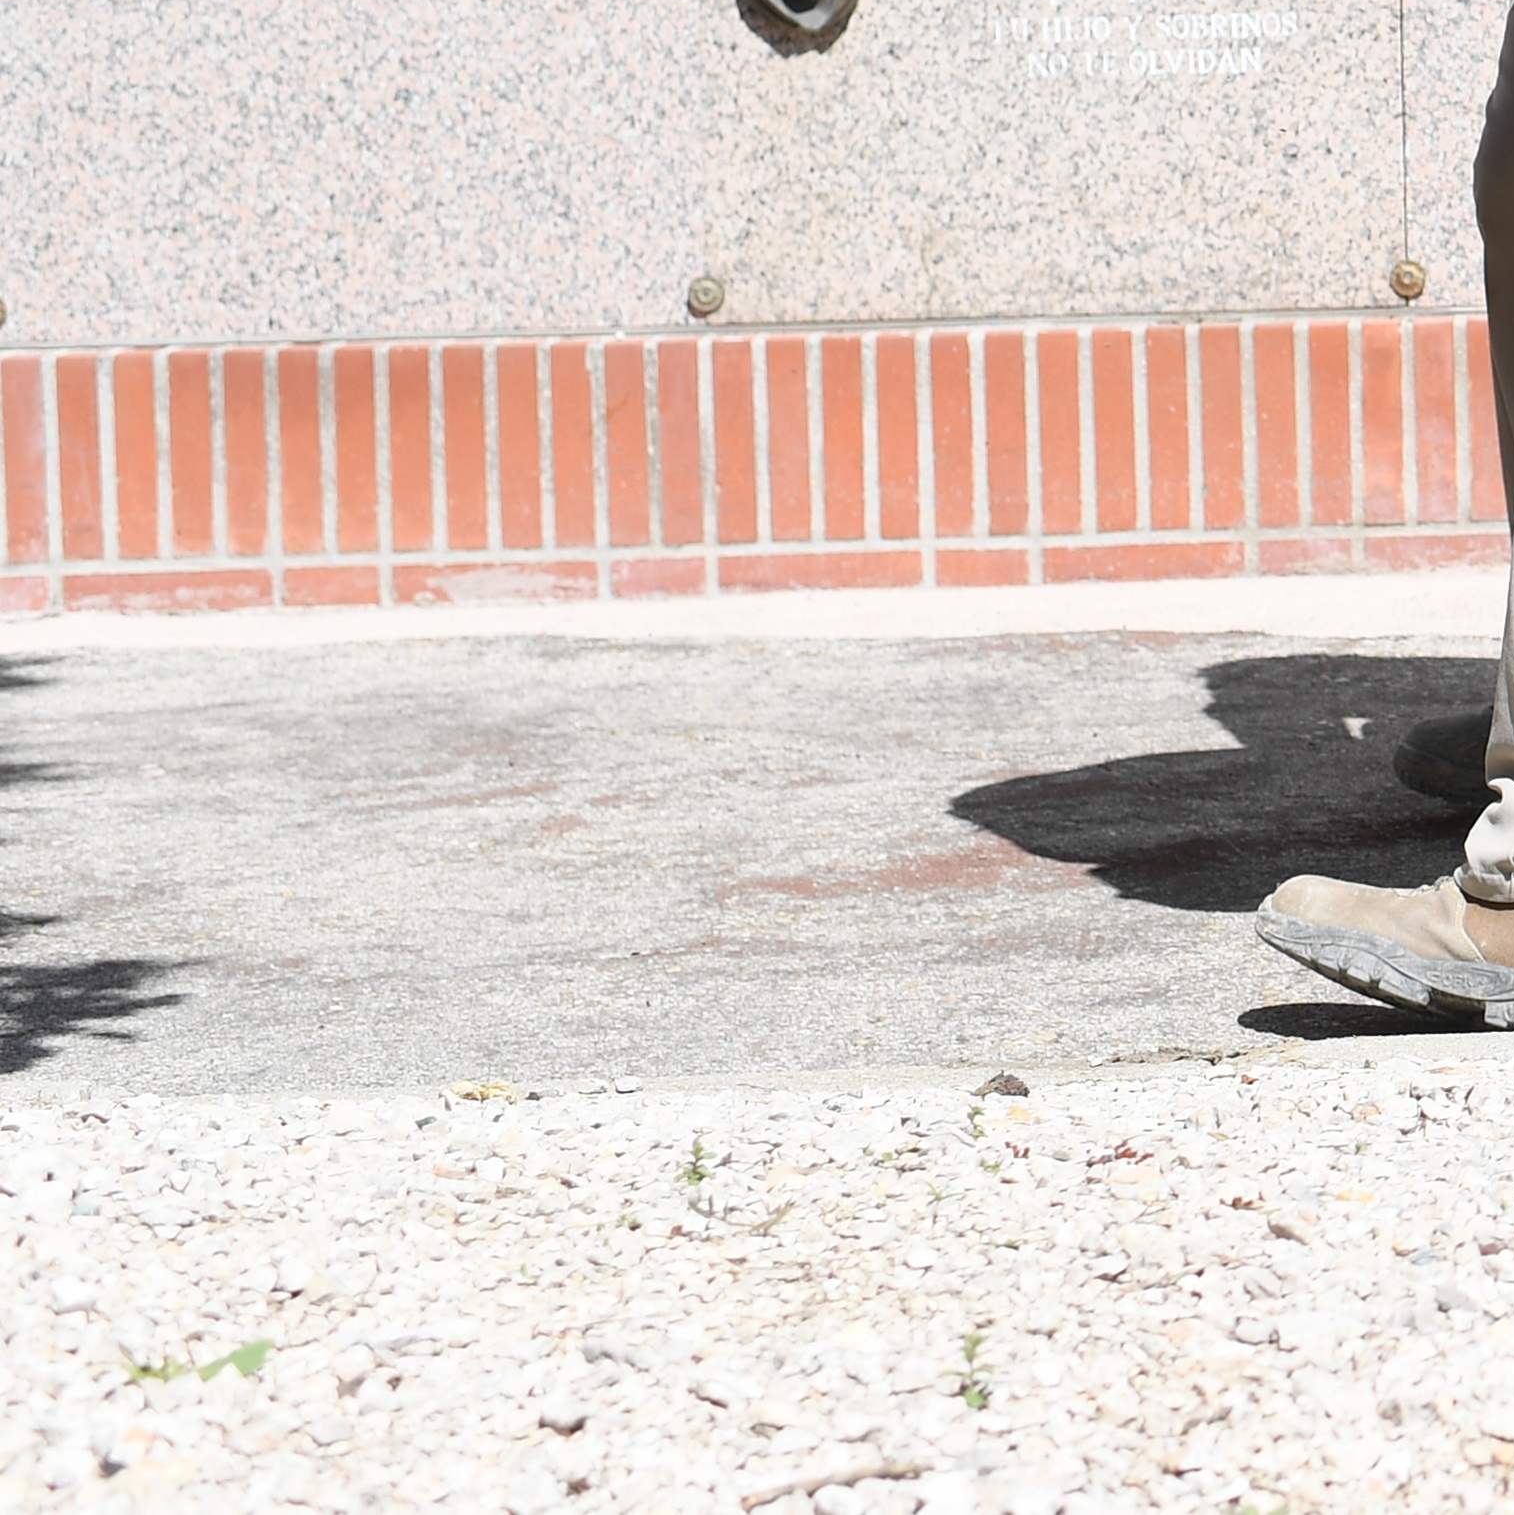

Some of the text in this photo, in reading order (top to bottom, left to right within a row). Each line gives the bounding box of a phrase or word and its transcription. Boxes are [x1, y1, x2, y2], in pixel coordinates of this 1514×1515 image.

[1154, 11, 1299, 40] SOBRINOS
[1027, 51, 1069, 79] NO
[1128, 46, 1264, 77] OLVIDAN
